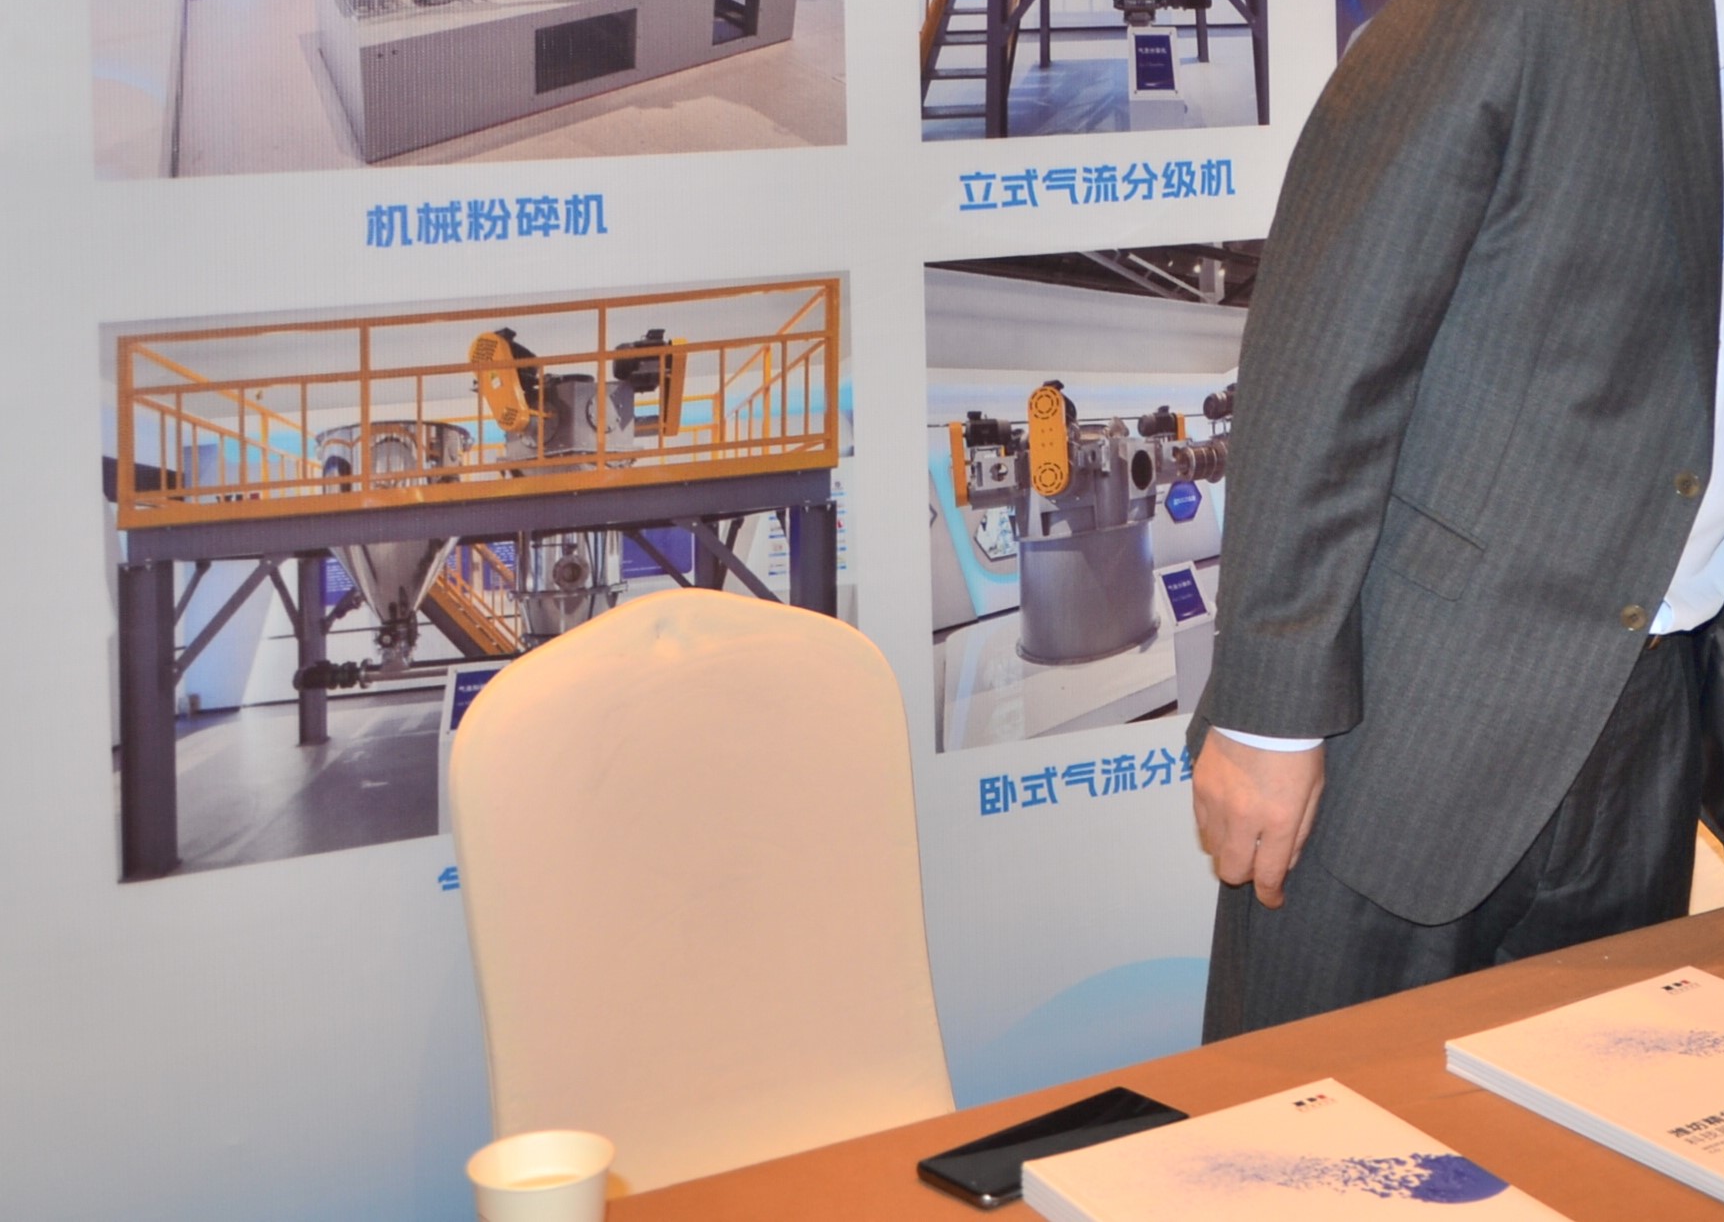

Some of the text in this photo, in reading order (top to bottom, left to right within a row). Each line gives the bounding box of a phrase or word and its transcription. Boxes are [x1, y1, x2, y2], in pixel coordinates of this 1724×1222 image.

[959, 159, 1236, 211] 立式气流分级机
[366, 194, 608, 247] 机械粉碎机
